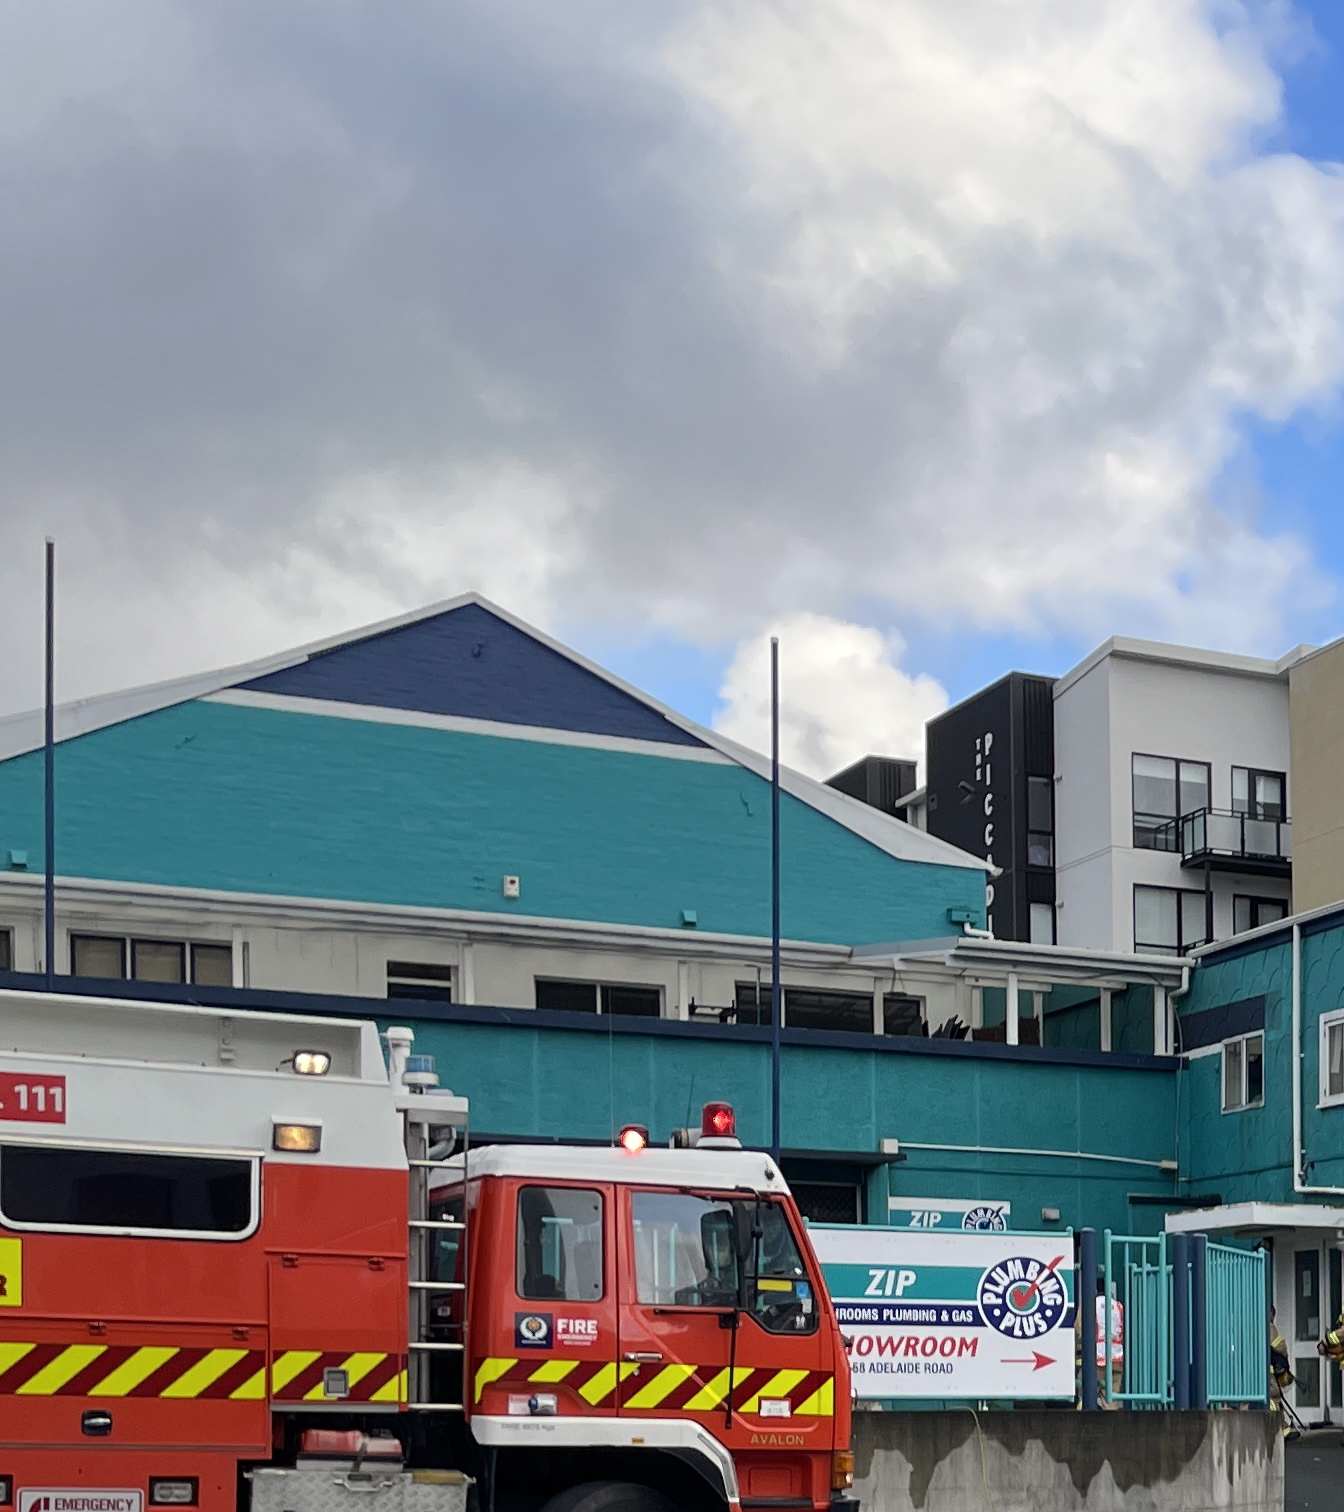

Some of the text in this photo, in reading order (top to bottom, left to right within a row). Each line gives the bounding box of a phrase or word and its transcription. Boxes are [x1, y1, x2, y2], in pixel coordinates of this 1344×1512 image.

[14, 1083, 64, 1113] 111
[909, 1210, 943, 1228] ZIP
[864, 1269, 917, 1297] ZIP
[836, 1308, 973, 1323] ROOMS PLUMBING & GAS
[557, 1318, 598, 1335] FIRE
[999, 1311, 1048, 1338] PLUS
[848, 1335, 979, 1358] OWROOM
[868, 1362, 921, 1374] ADELAIDE
[924, 1362, 953, 1374] ROAD
[750, 1434, 804, 1446] AVALON
[54, 1497, 134, 1512] EMERGENCY
